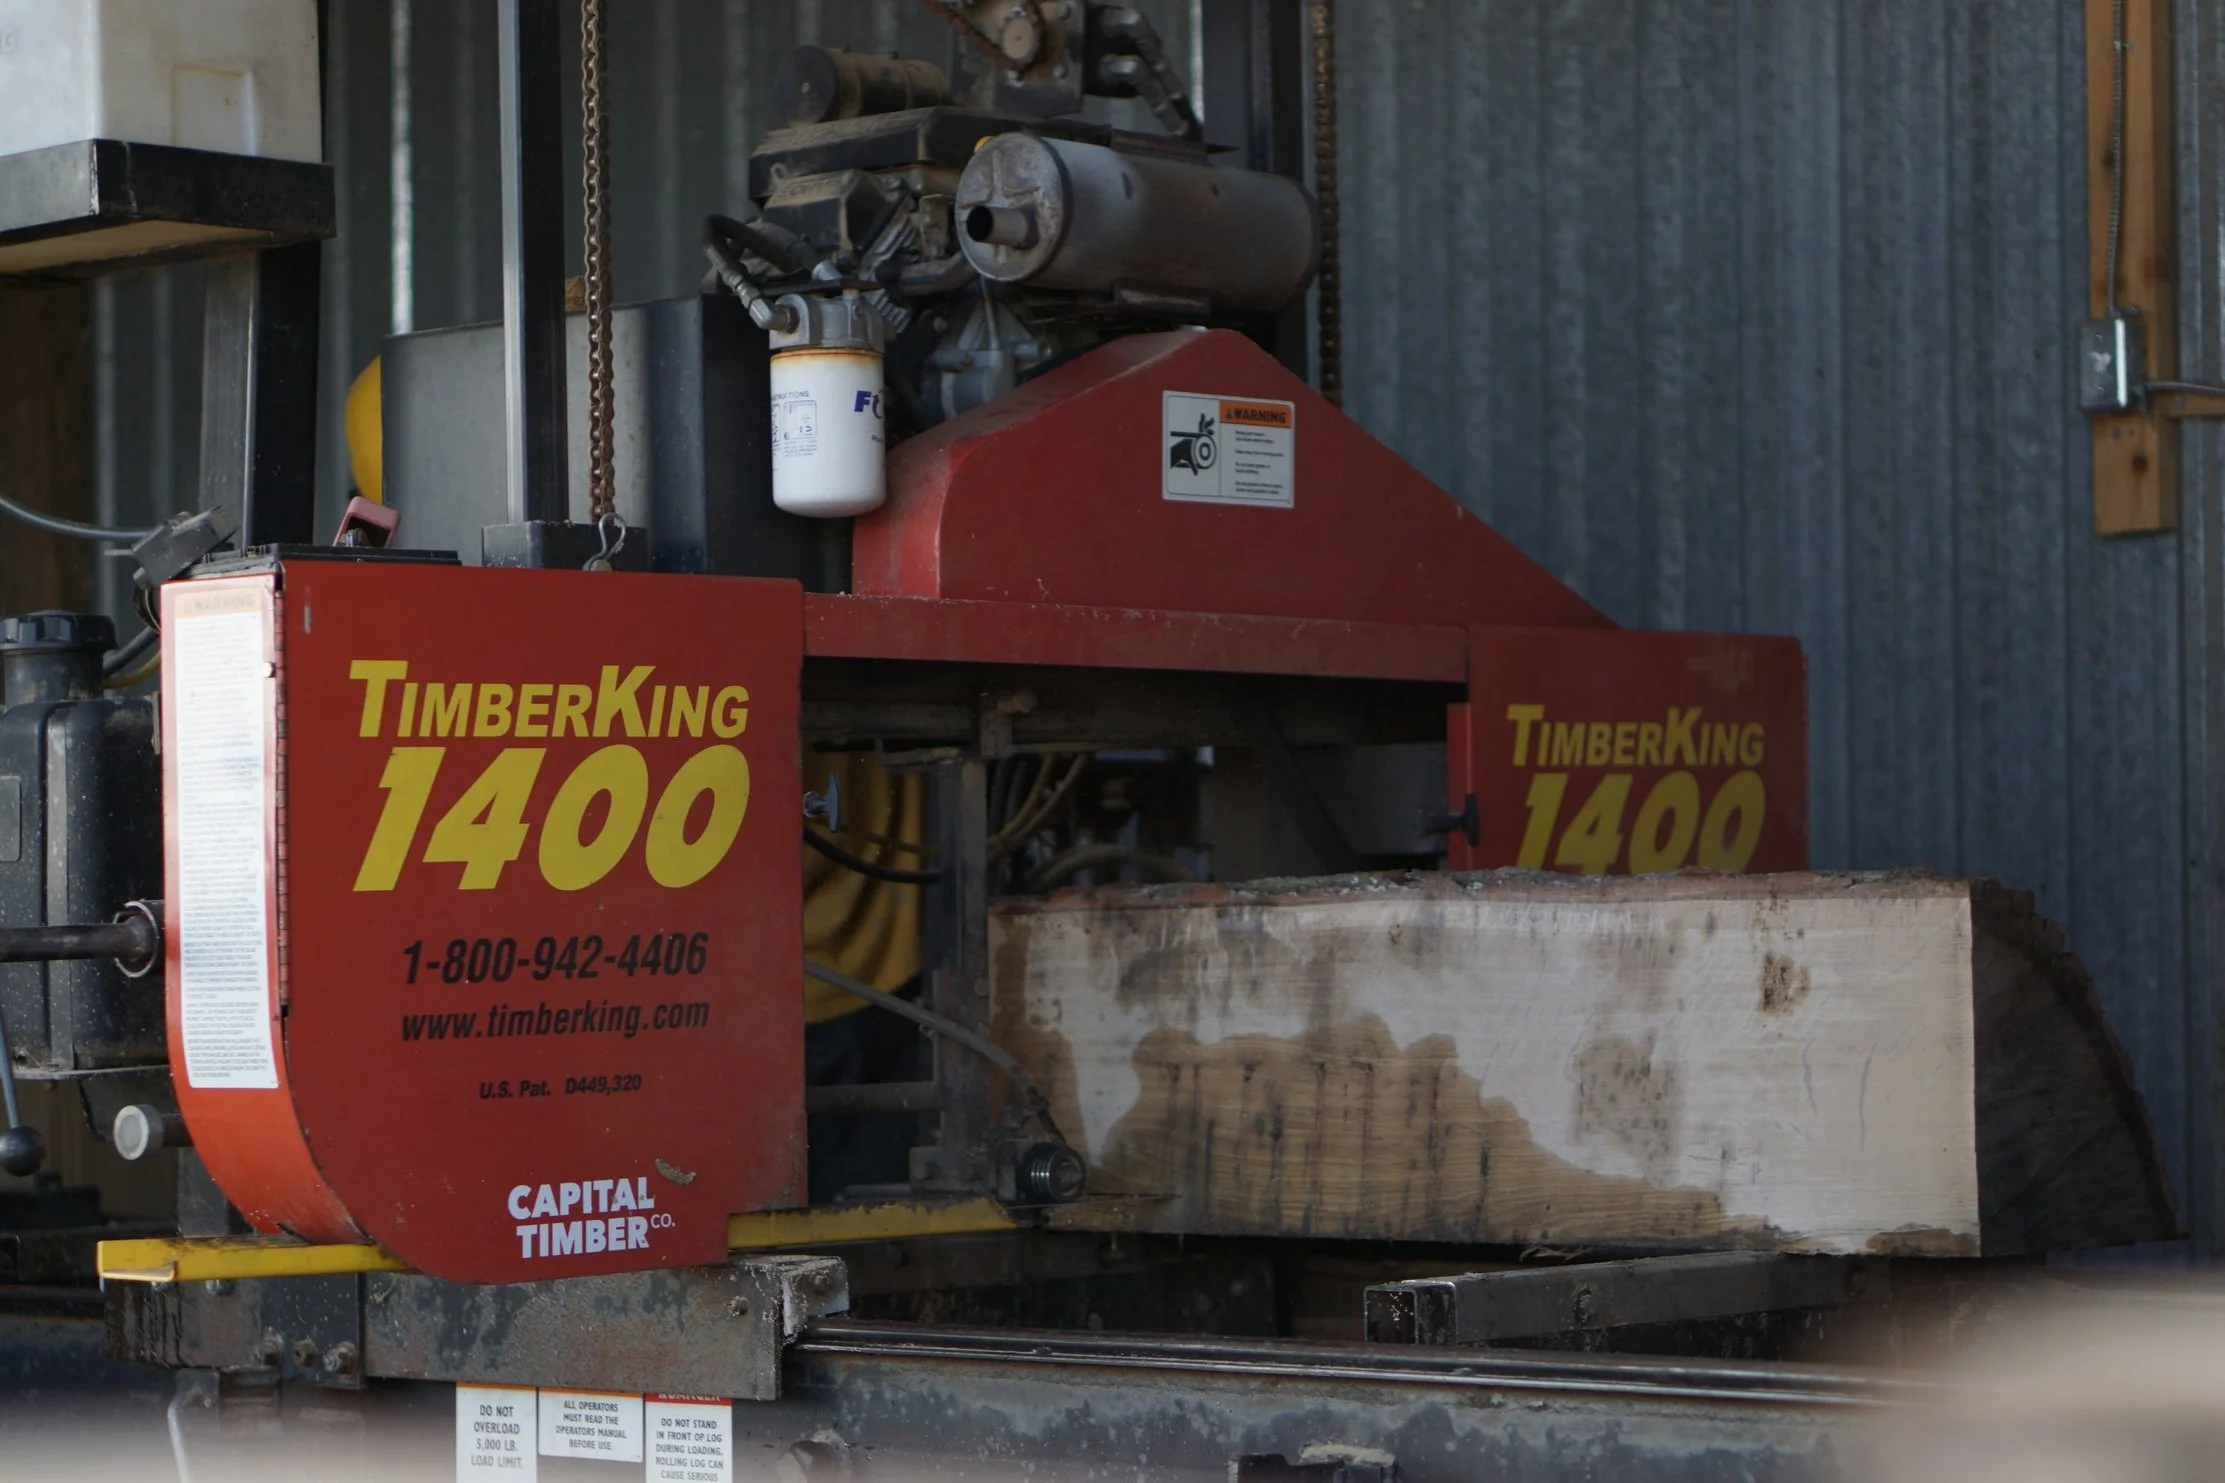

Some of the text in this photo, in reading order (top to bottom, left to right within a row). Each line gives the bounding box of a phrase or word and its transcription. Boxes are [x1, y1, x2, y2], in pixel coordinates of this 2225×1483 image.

[1234, 408, 1287, 424] WARNING
[353, 744, 750, 891] 1400
[1515, 769, 1766, 876] 1400
[403, 932, 709, 985] 1-800-942-4406
[402, 1001, 710, 1041] www.timberking.com
[479, 1074, 642, 1099] U.S. Pat. D449,320
[508, 1177, 655, 1220] CAPITAL
[516, 1213, 676, 1259] TIMBER CO.
[479, 1405, 514, 1417] DO NOT
[563, 1400, 618, 1412] ALL OPERATORS
[563, 1413, 619, 1425] MUST READ THE
[661, 1418, 717, 1429] DO NOT STAND
[473, 1421, 520, 1435] OVERLOAD
[555, 1425, 626, 1438] OPERATORS MANUAL
[656, 1430, 664, 1439] IN
[667, 1431, 692, 1440] FRONT
[707, 1433, 722, 1443] LOG
[569, 1439, 596, 1449] BEFORE
[656, 1444, 685, 1453] DURING
[470, 1453, 494, 1466] LOAD
[655, 1457, 723, 1469] ROLLING LOG CAN
[661, 1469, 718, 1482] CAUSE SERIOUS
